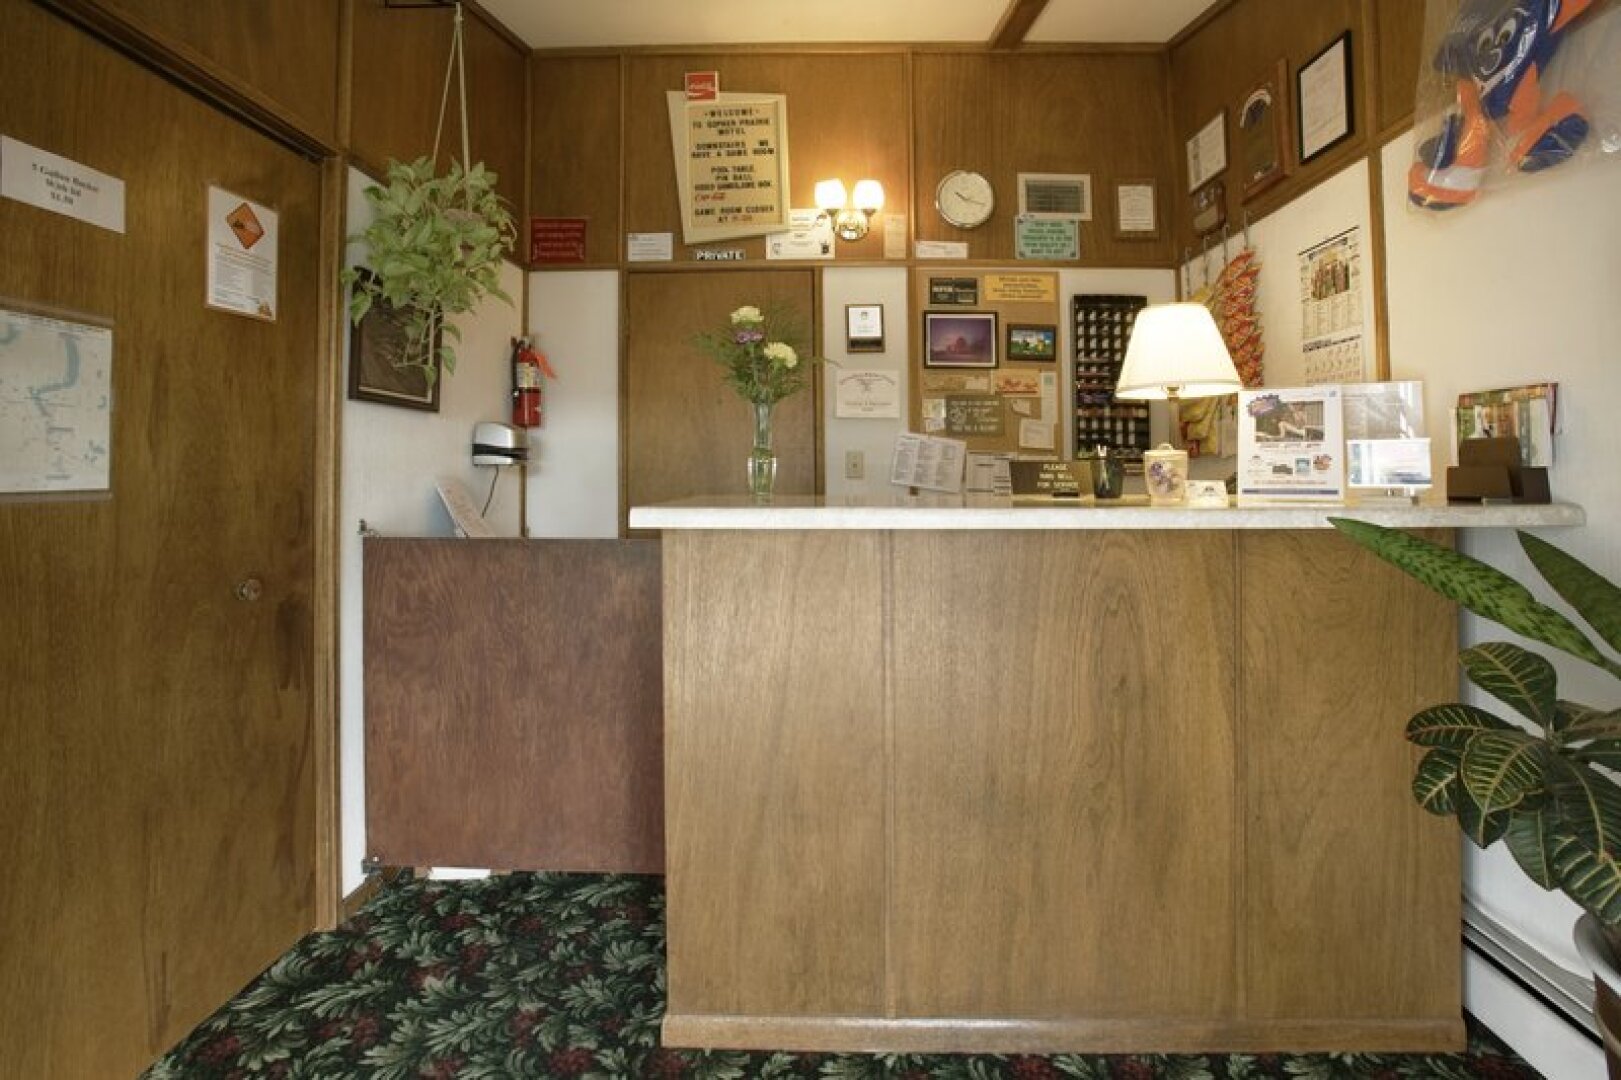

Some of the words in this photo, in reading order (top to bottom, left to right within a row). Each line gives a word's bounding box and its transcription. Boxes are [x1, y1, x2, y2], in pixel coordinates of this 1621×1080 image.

[694, 207, 715, 216] GAME
[720, 206, 742, 214] ROOM
[695, 250, 745, 260] PRIVATE
[1043, 463, 1068, 471] PLEASE
